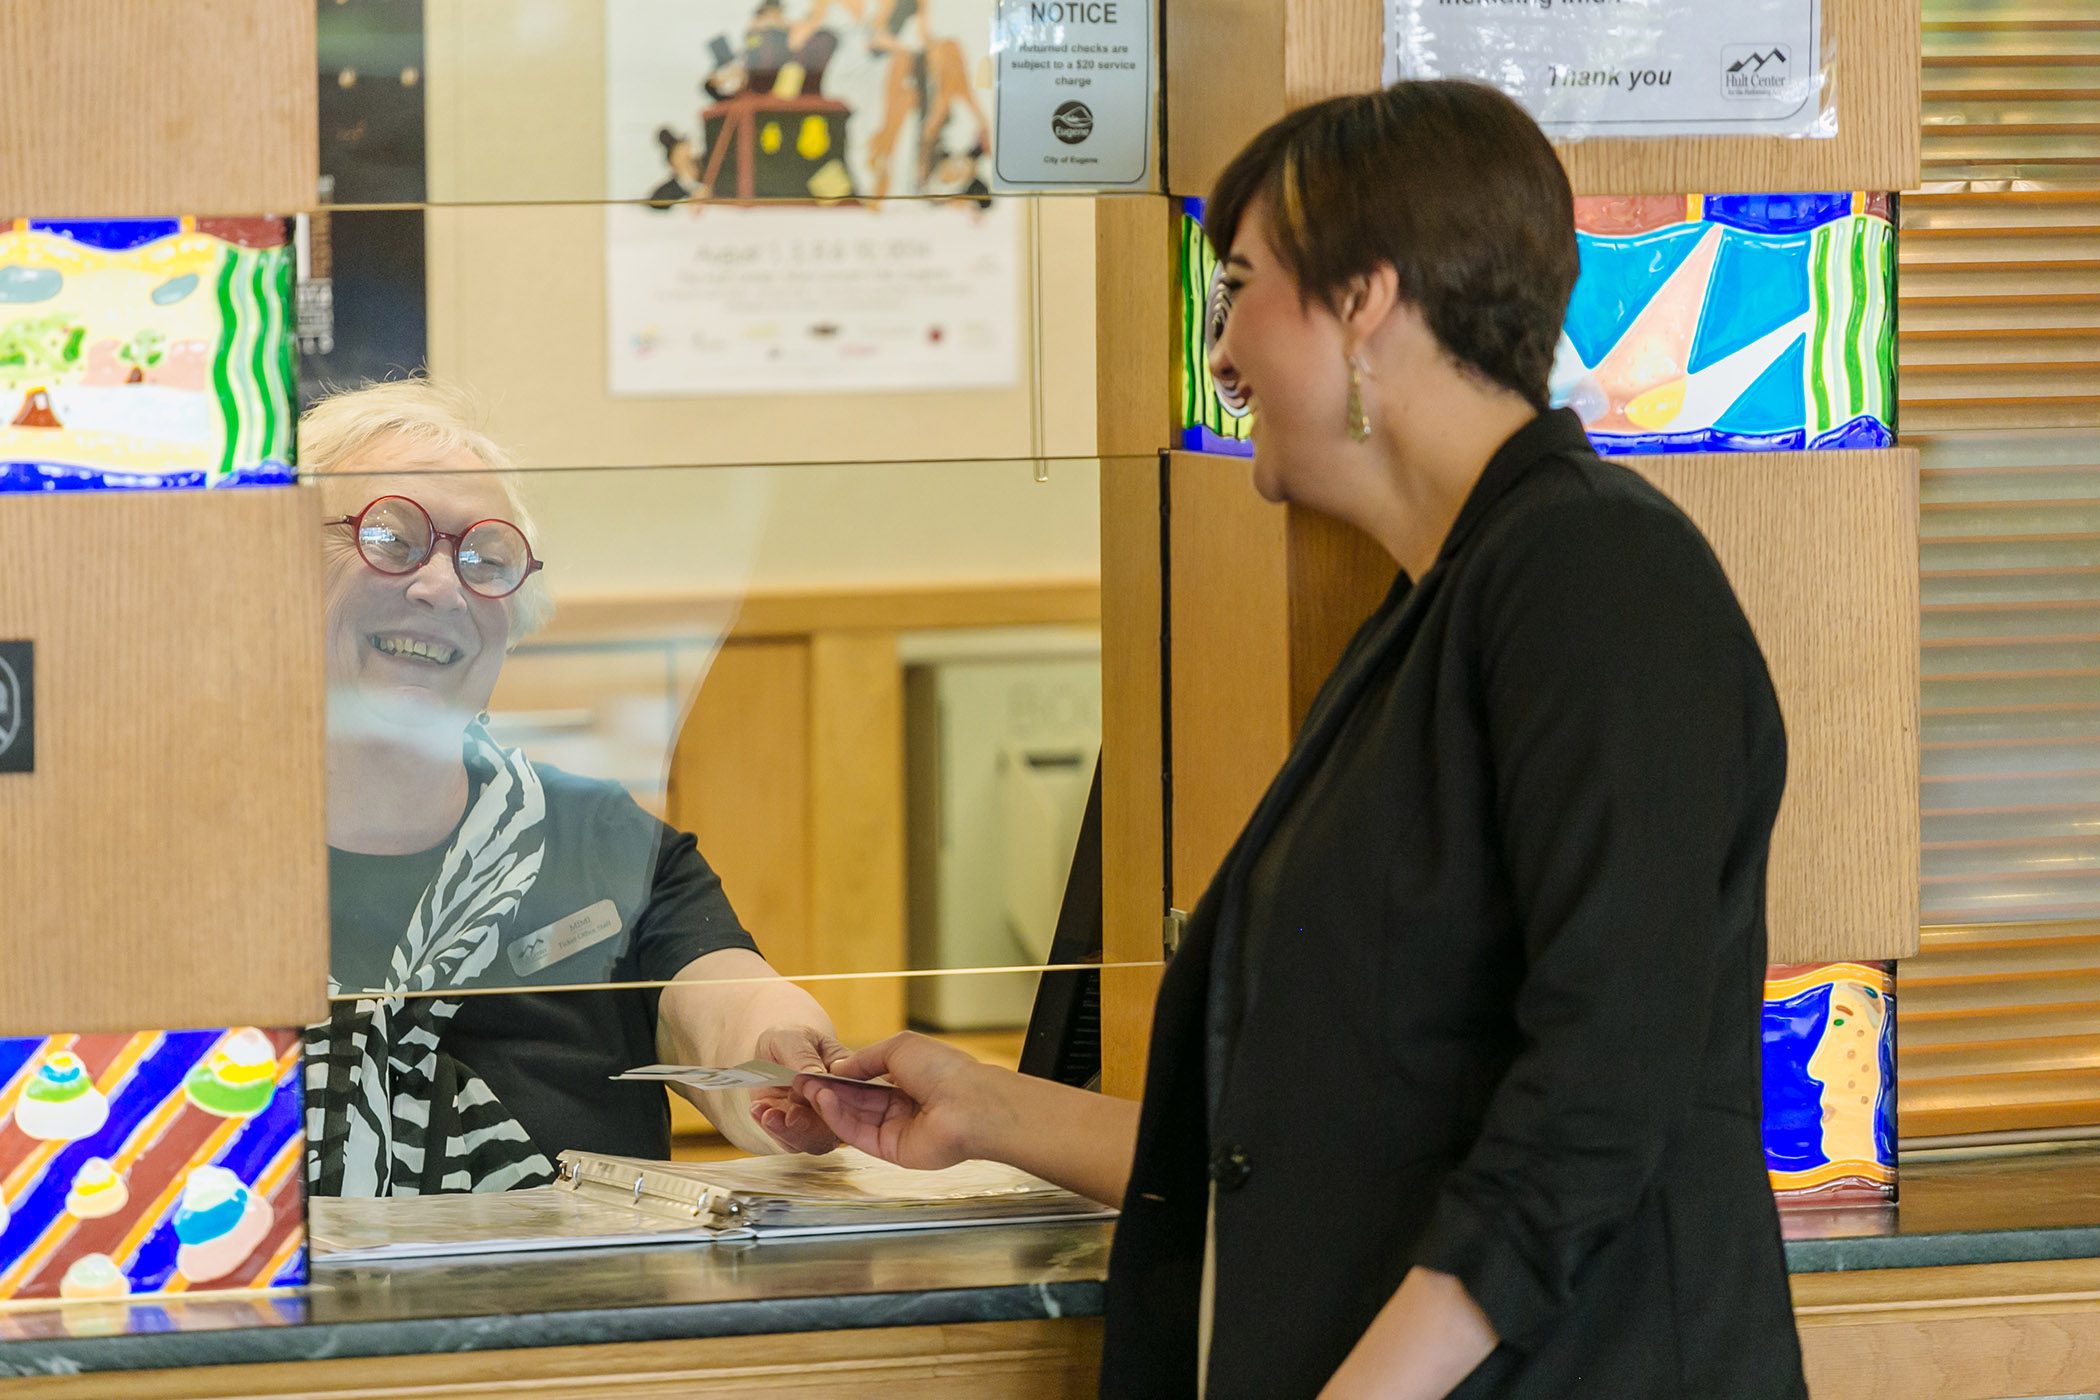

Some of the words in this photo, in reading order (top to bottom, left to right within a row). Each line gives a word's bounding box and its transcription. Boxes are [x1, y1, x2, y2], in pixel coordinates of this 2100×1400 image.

[1031, 2, 1118, 24] NOTICE
[1019, 42, 1068, 53] Returned
[1071, 42, 1109, 53] checks
[1111, 45, 1128, 53] are
[1011, 60, 1050, 70] subject
[1053, 60, 1064, 69] to
[1076, 60, 1095, 70] $20
[1098, 60, 1136, 69] service
[1055, 76, 1092, 87] charge
[1548, 65, 1621, 87] Thank
[1627, 70, 1672, 91] you
[1726, 73, 1749, 87] Hult
[1750, 72, 1786, 88] Center
[1043, 155, 1058, 164] City
[1070, 155, 1098, 165] Eugene
